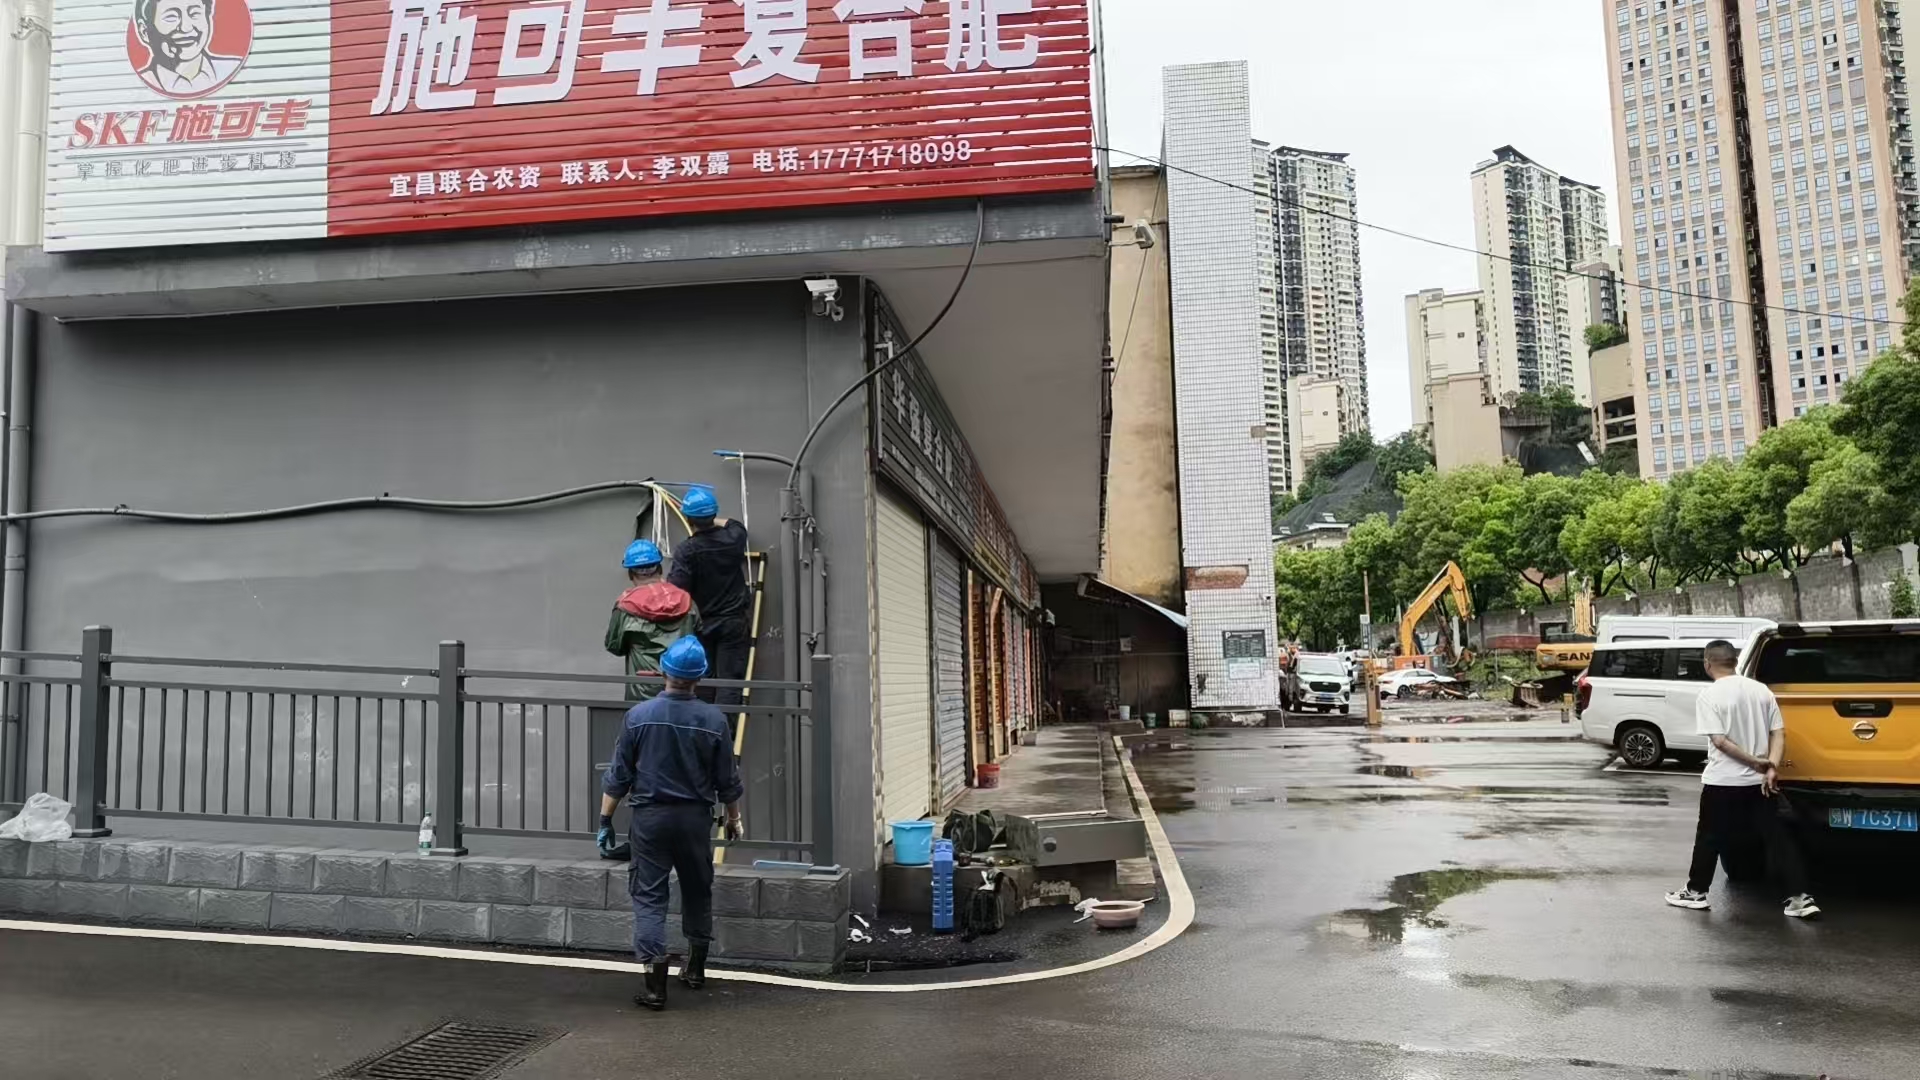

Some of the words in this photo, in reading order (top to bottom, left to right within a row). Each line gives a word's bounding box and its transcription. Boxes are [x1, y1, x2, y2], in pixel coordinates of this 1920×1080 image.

[370, 0, 1038, 115] 施可丰复合肥
[389, 165, 541, 197] 宜昌联合农资
